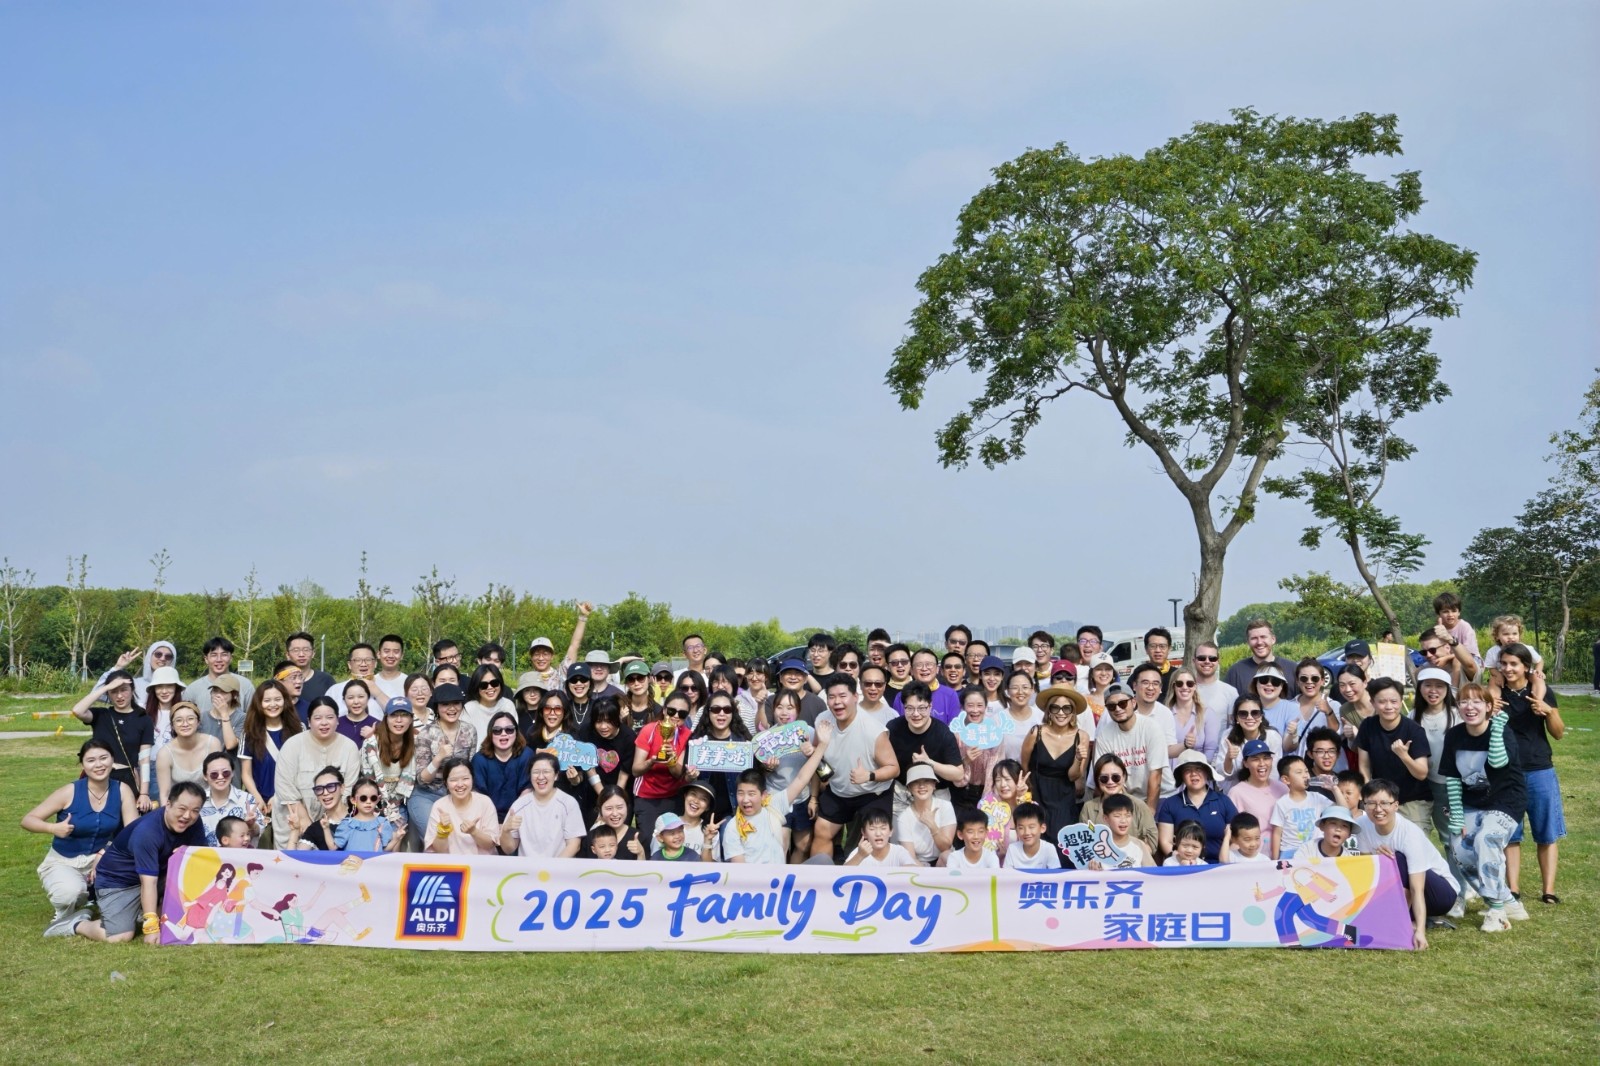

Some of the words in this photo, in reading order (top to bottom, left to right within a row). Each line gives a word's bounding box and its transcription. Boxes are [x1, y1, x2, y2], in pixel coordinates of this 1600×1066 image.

[697, 746, 745, 766] 美美哒
[1064, 830, 1094, 848] 超级
[1074, 845, 1095, 866] 棒
[1018, 880, 1144, 909] 奥乐齐
[409, 907, 455, 922] ALDI
[519, 888, 648, 931] 2025
[667, 872, 817, 941] Family
[832, 875, 942, 945] Day
[415, 923, 447, 933] 奥乐齐
[1104, 912, 1231, 942] 家庭日
